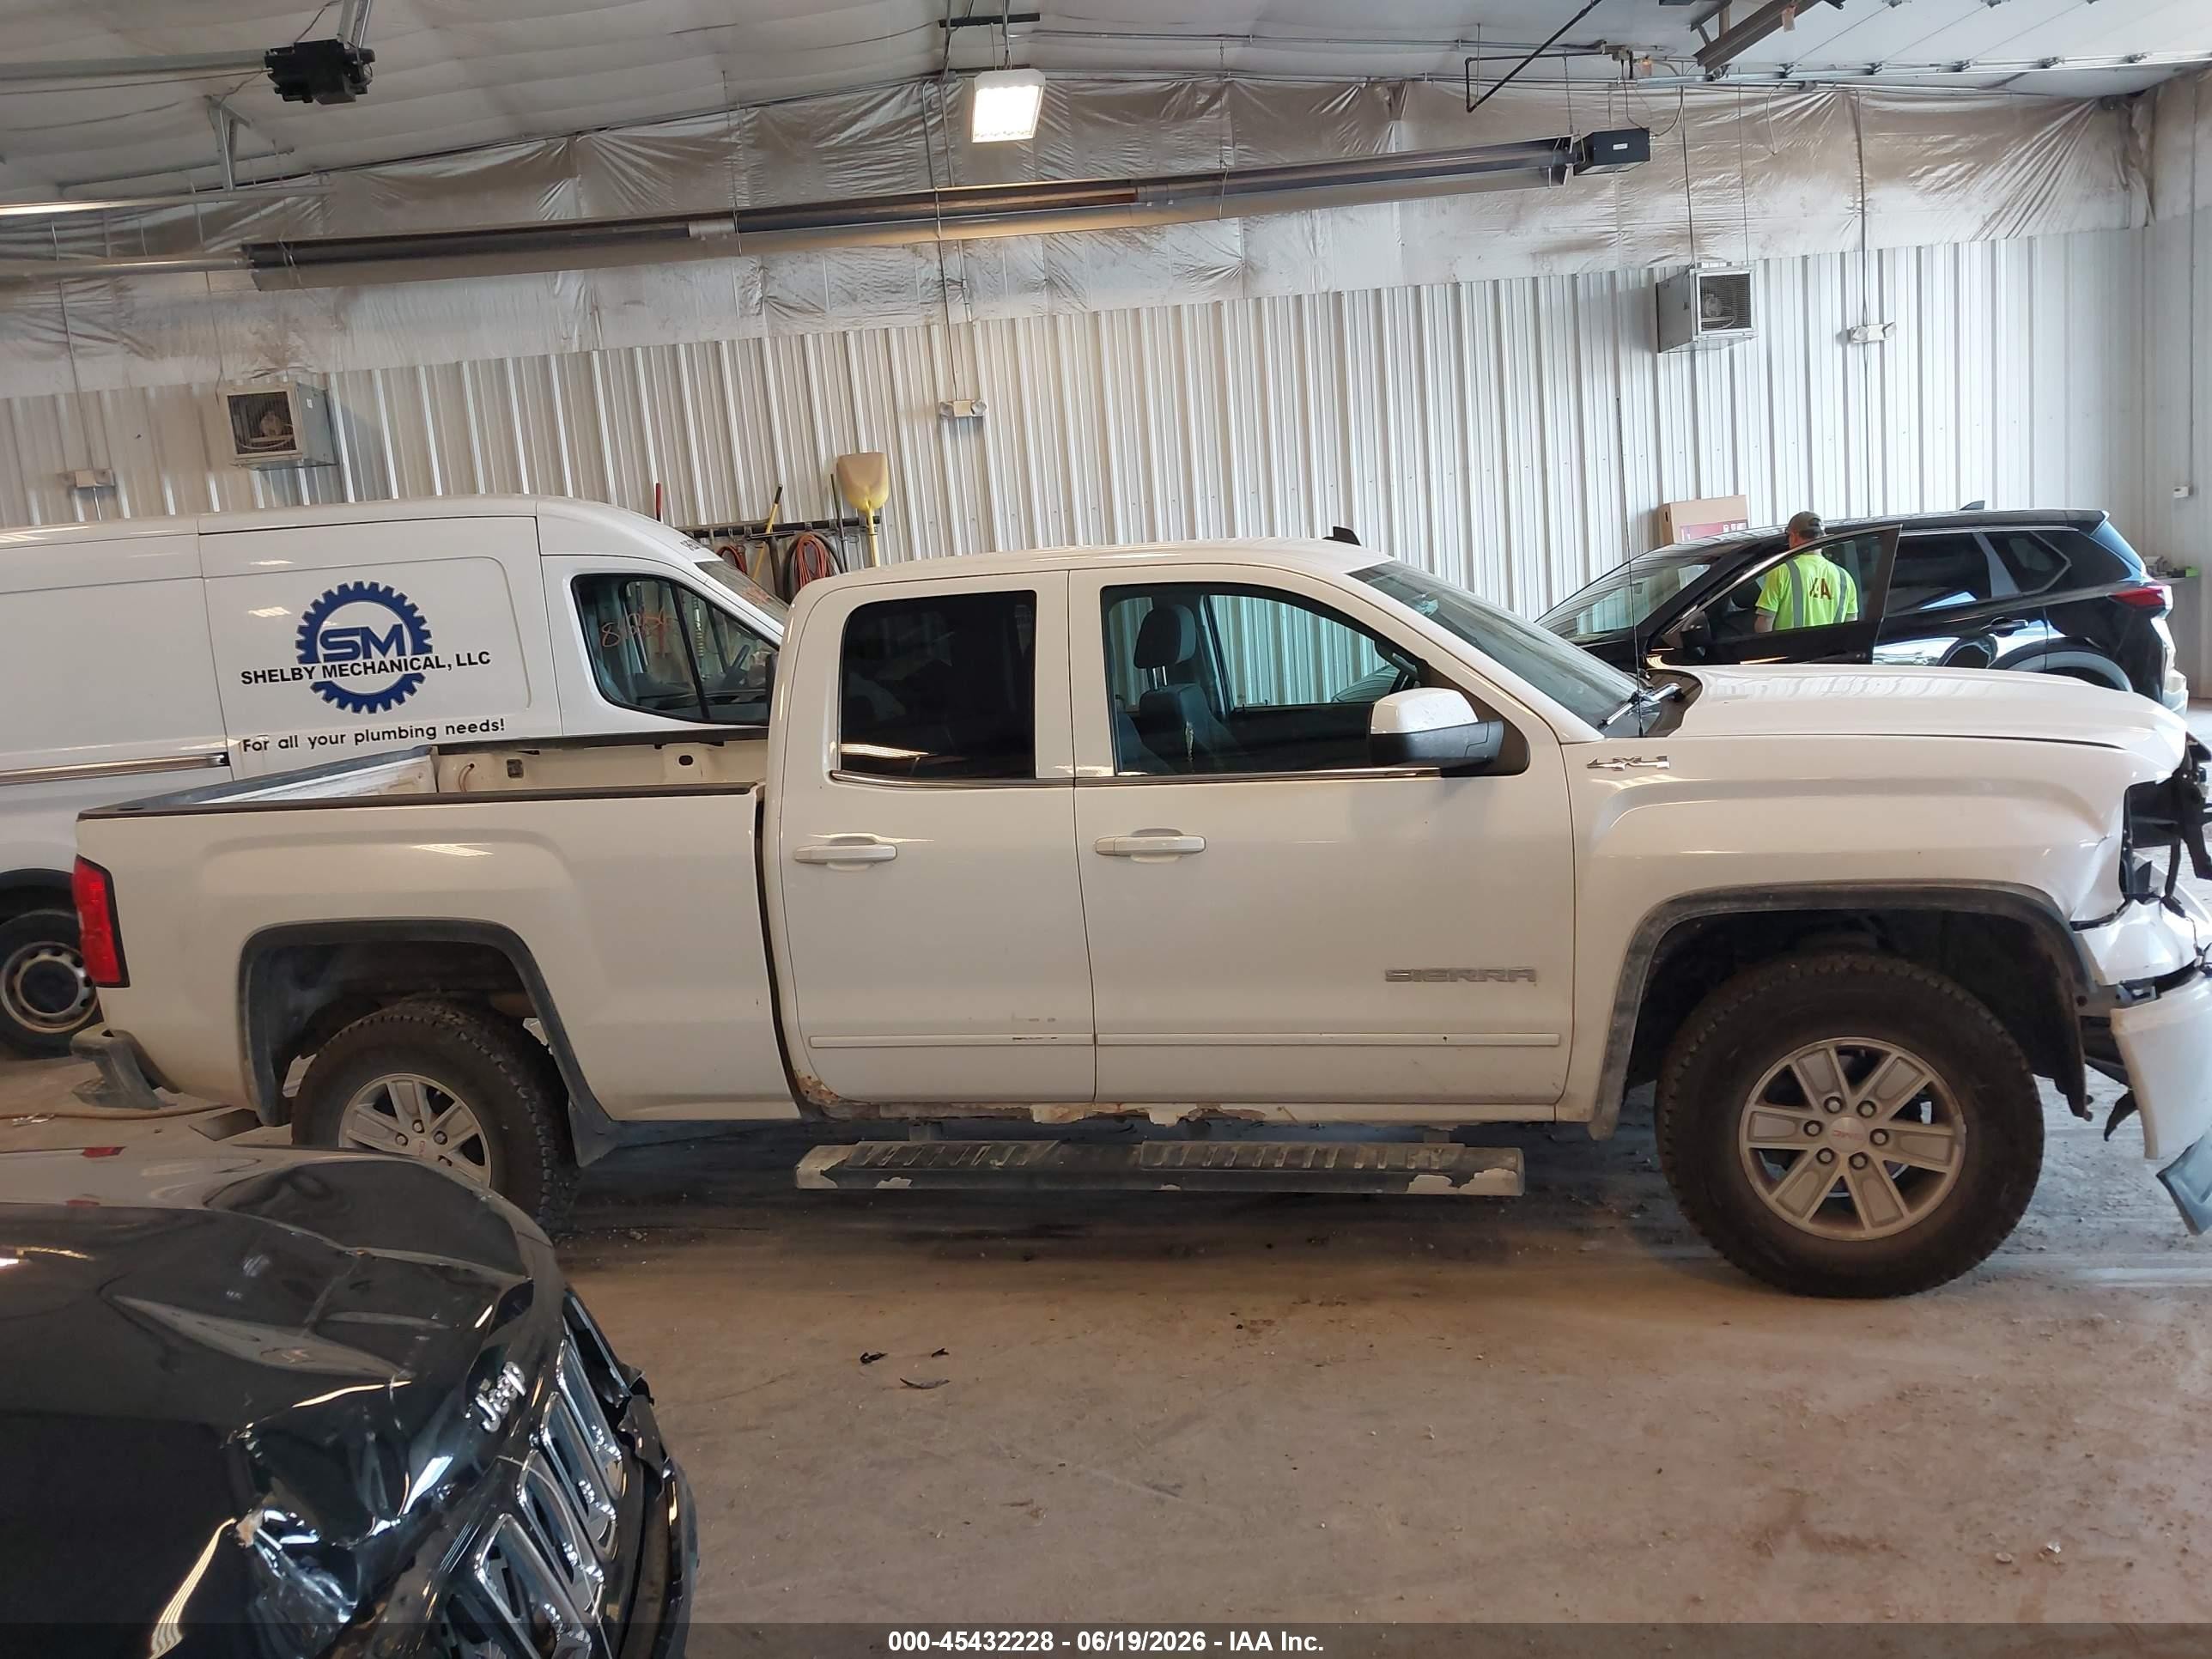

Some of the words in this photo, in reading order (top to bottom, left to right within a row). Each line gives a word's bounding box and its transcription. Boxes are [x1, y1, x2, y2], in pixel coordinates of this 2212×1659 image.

[319, 624, 407, 662] SM
[240, 665, 316, 685] SHELBY
[322, 655, 453, 678] MECHANICAL,
[456, 651, 492, 668] LLC
[243, 738, 270, 752] For
[277, 735, 299, 750] all
[307, 732, 346, 749] your
[354, 725, 437, 745] plumbing
[445, 718, 505, 736] needs!
[1384, 968, 1537, 983] SIERRA
[474, 1361, 527, 1434] Jeep
